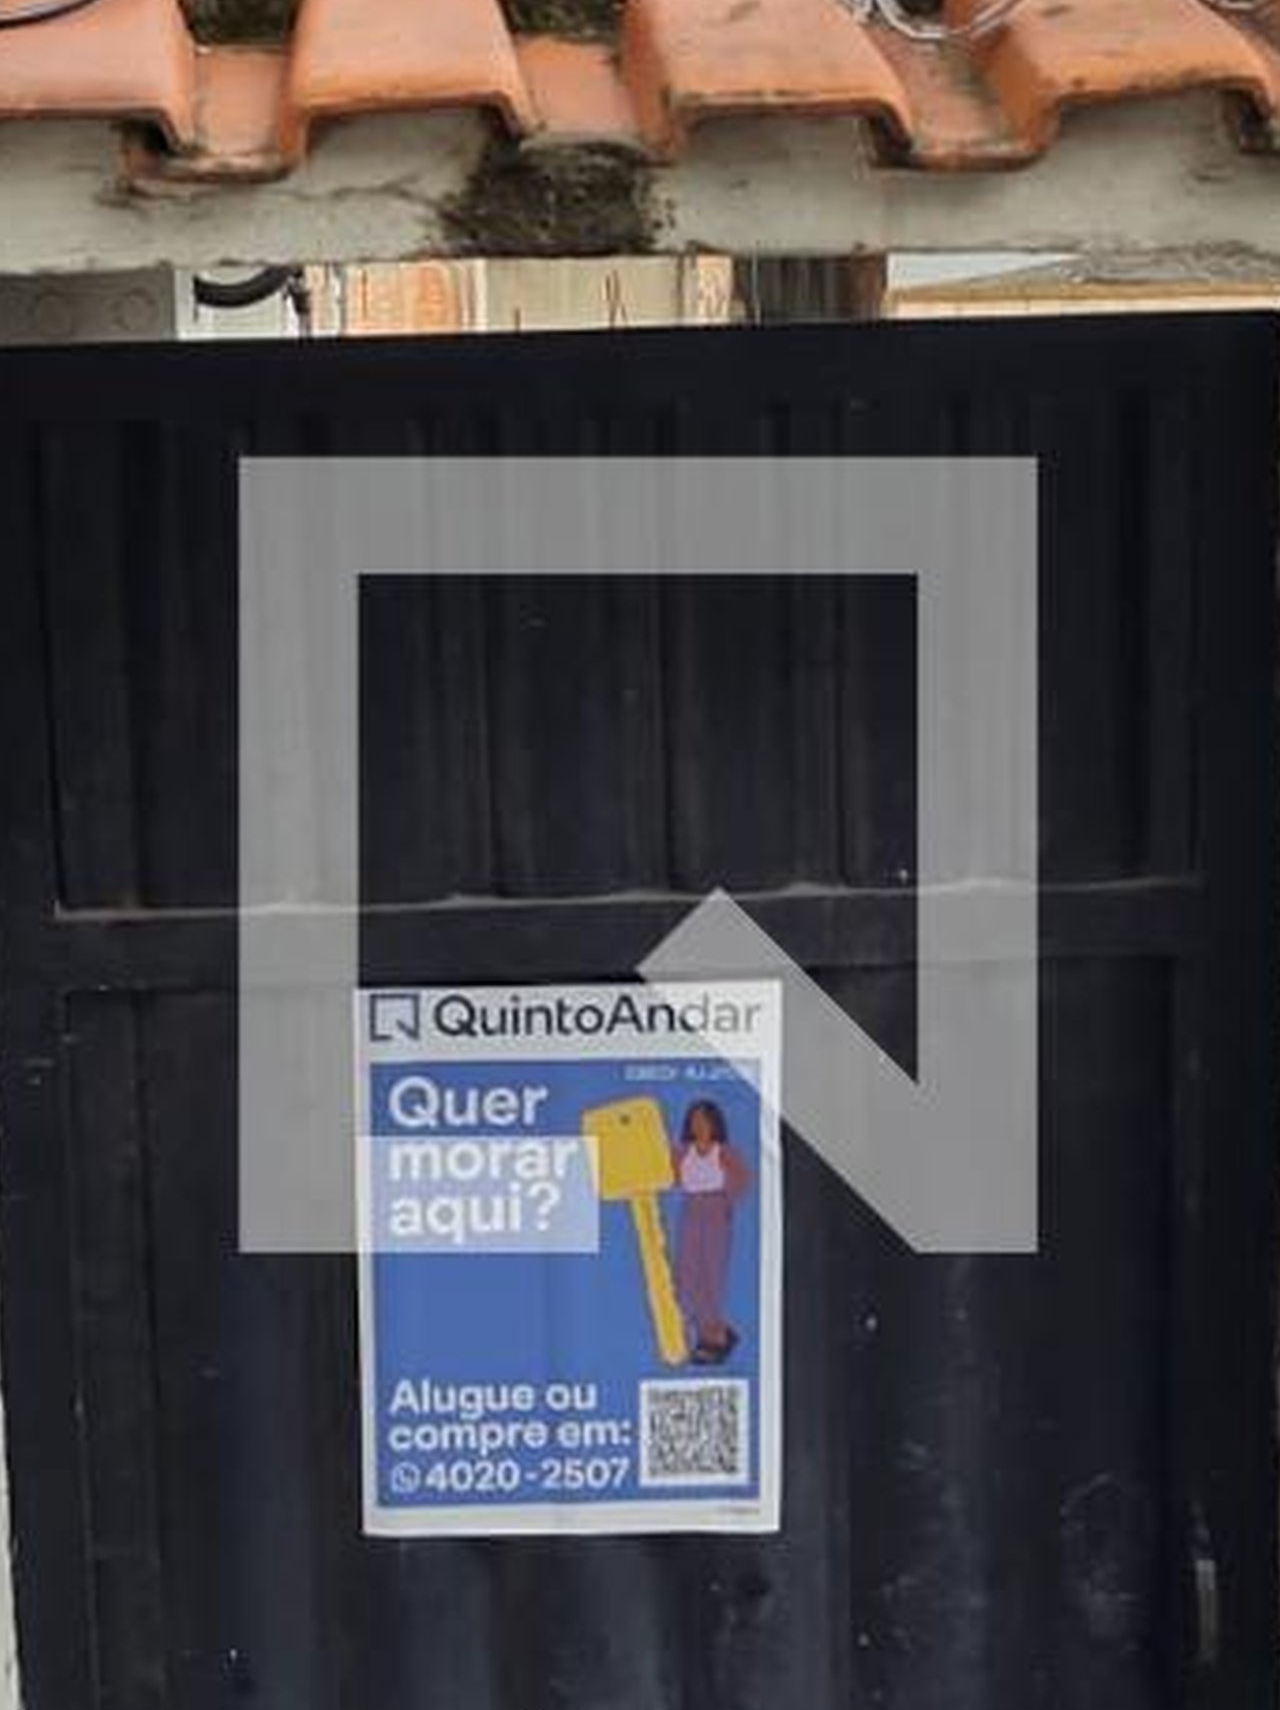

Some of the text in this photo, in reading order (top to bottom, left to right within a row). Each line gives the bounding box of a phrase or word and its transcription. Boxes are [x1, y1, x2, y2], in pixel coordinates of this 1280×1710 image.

[433, 994, 762, 1038] QuintoAndar
[388, 1076, 548, 1128] Quer
[388, 1139, 578, 1181] morar
[389, 1181, 561, 1245] aqui?
[389, 1379, 597, 1420] Alugue ou
[389, 1418, 632, 1457] compre em:
